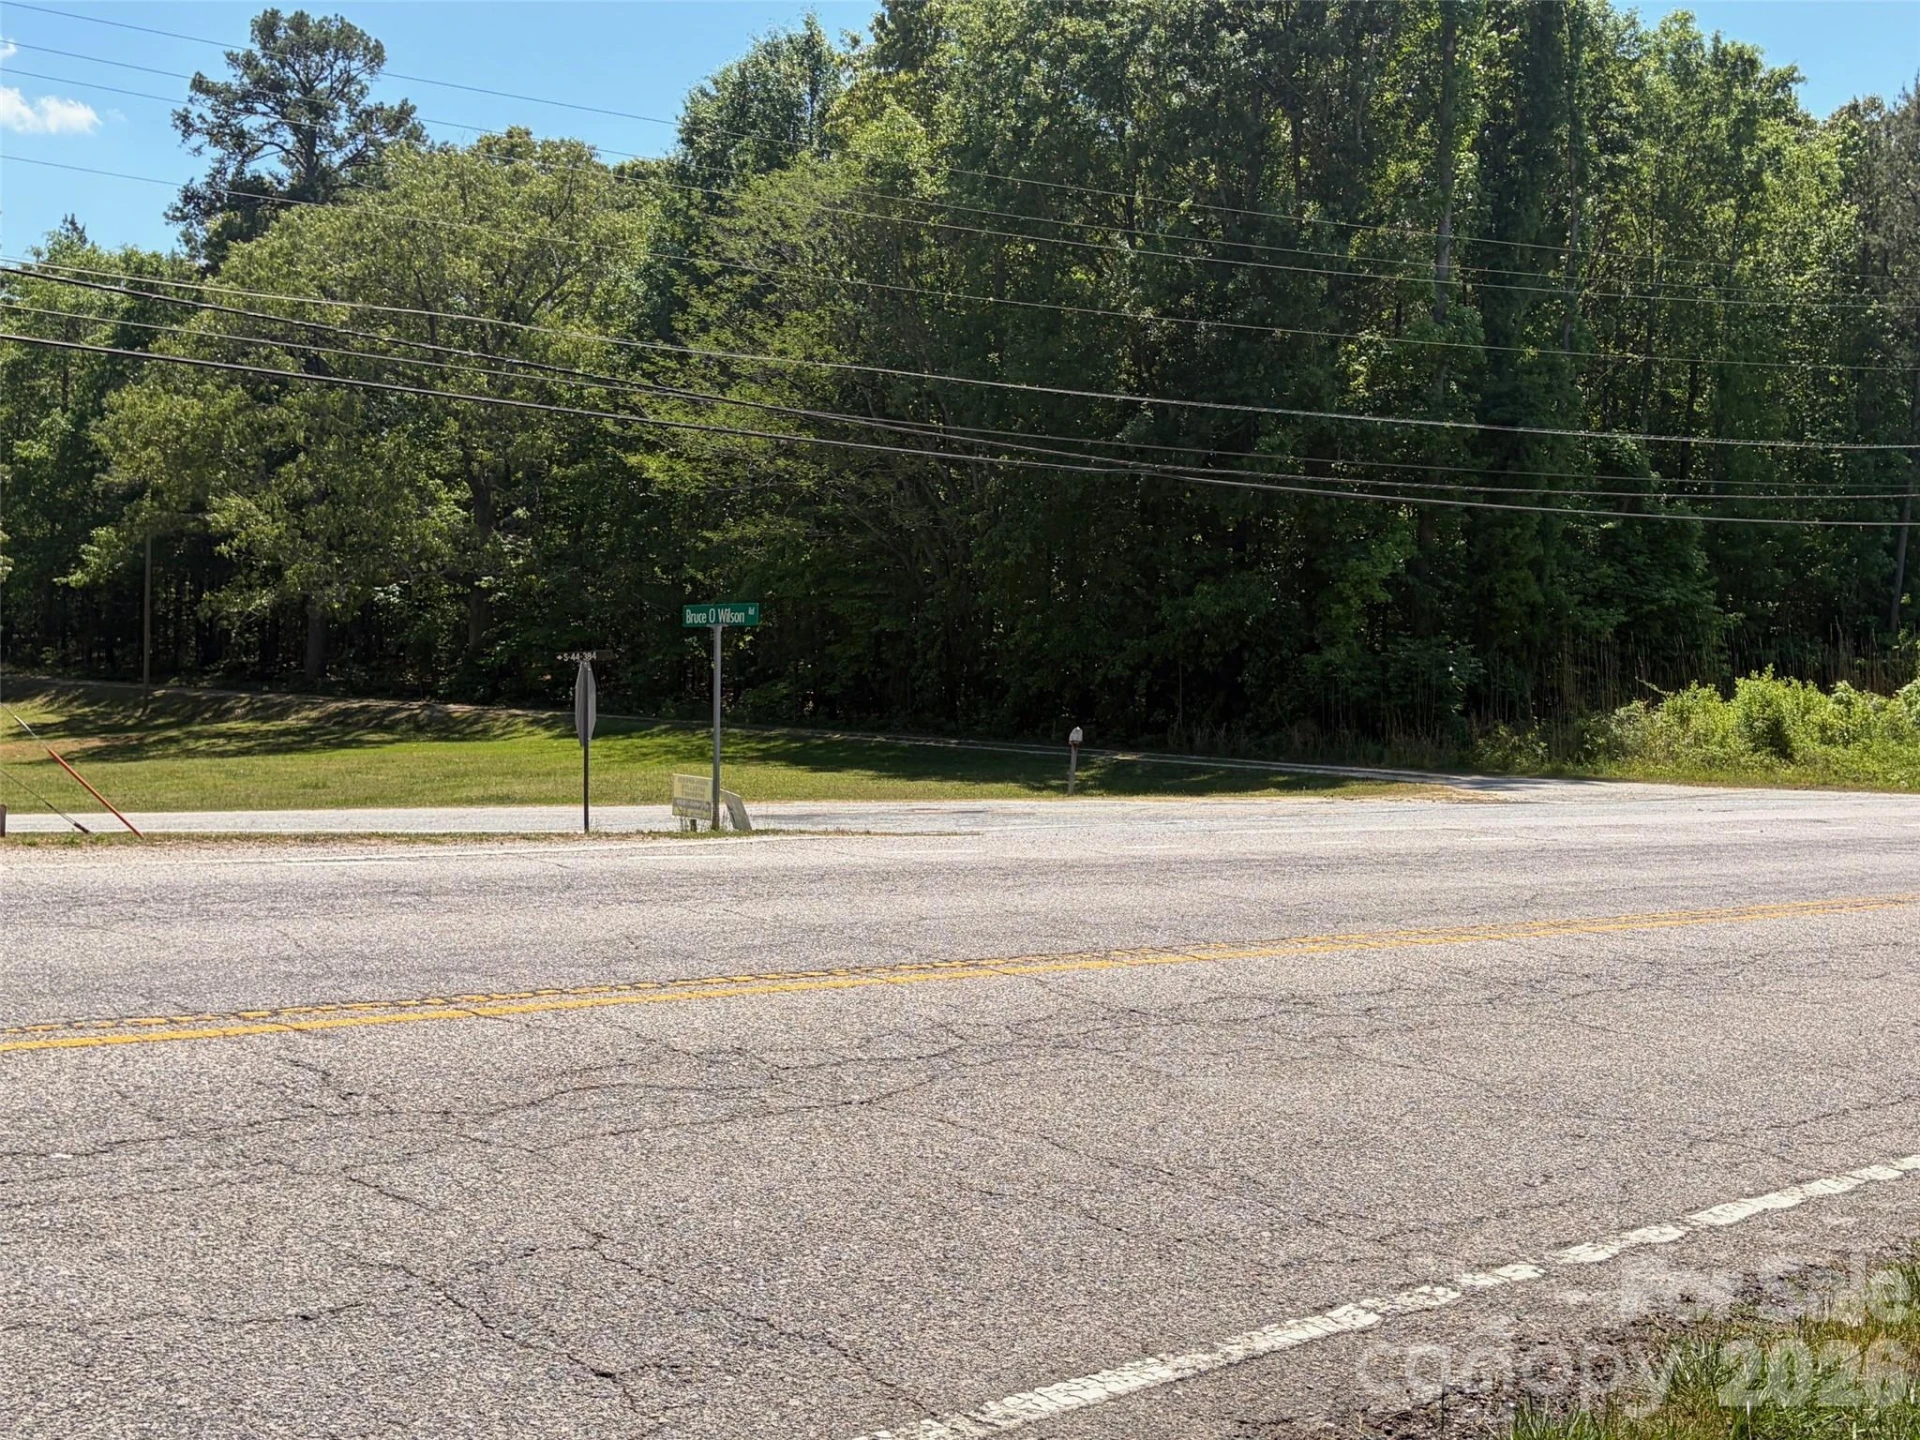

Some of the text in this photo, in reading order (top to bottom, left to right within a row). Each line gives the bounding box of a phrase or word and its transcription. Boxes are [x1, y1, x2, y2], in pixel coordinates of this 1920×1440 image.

[686, 606, 756, 624] Bruce O Wilson Rd
